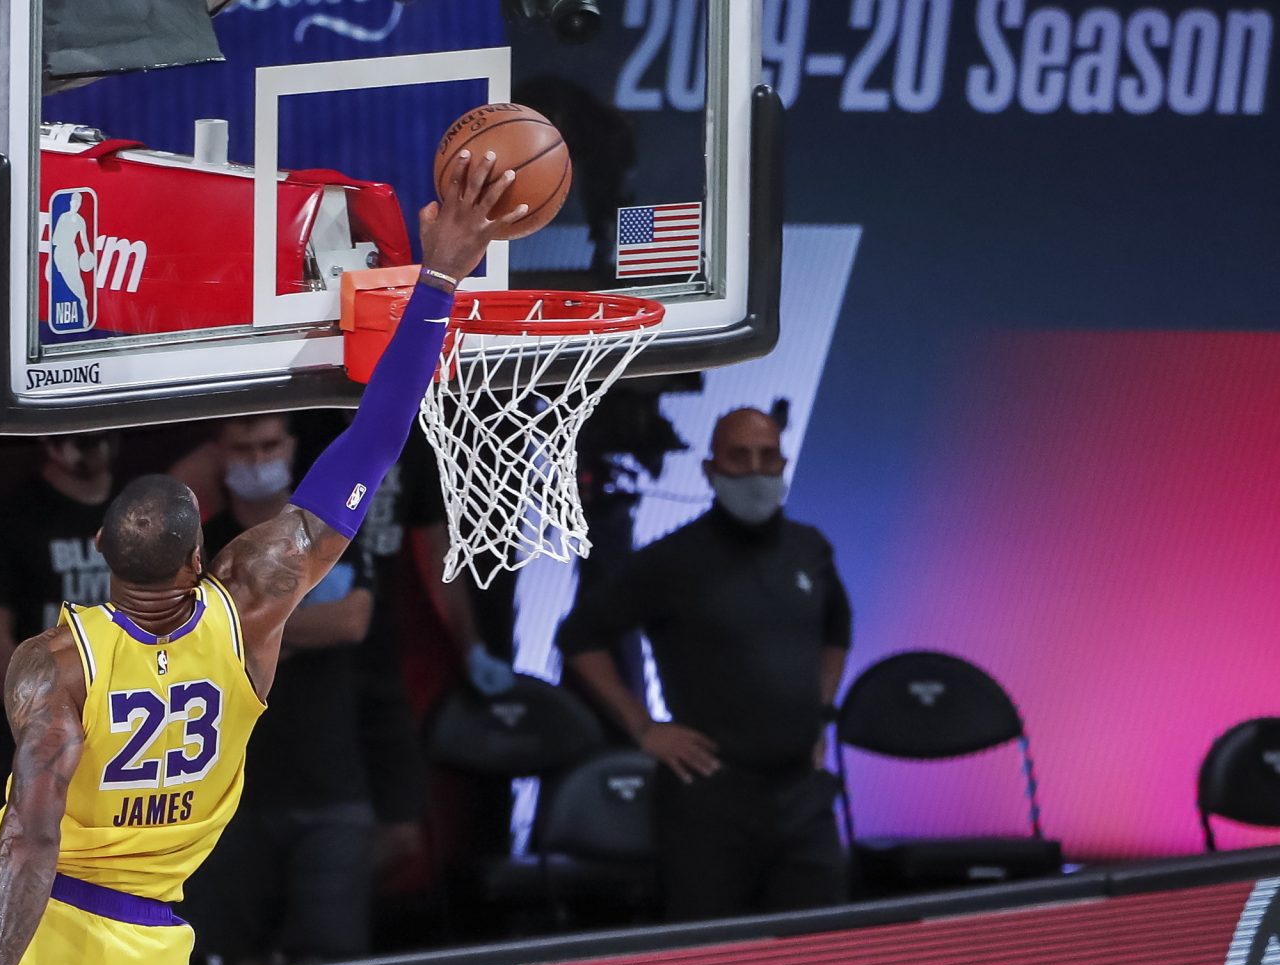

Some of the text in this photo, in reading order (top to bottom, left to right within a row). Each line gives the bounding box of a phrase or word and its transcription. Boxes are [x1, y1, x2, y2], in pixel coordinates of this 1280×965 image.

[614, 0, 1273, 116] 209-20 Season
[55, 301, 79, 324] NBA
[26, 362, 101, 390] SPALDING
[99, 678, 224, 791] 23
[113, 790, 193, 827] JAMES
